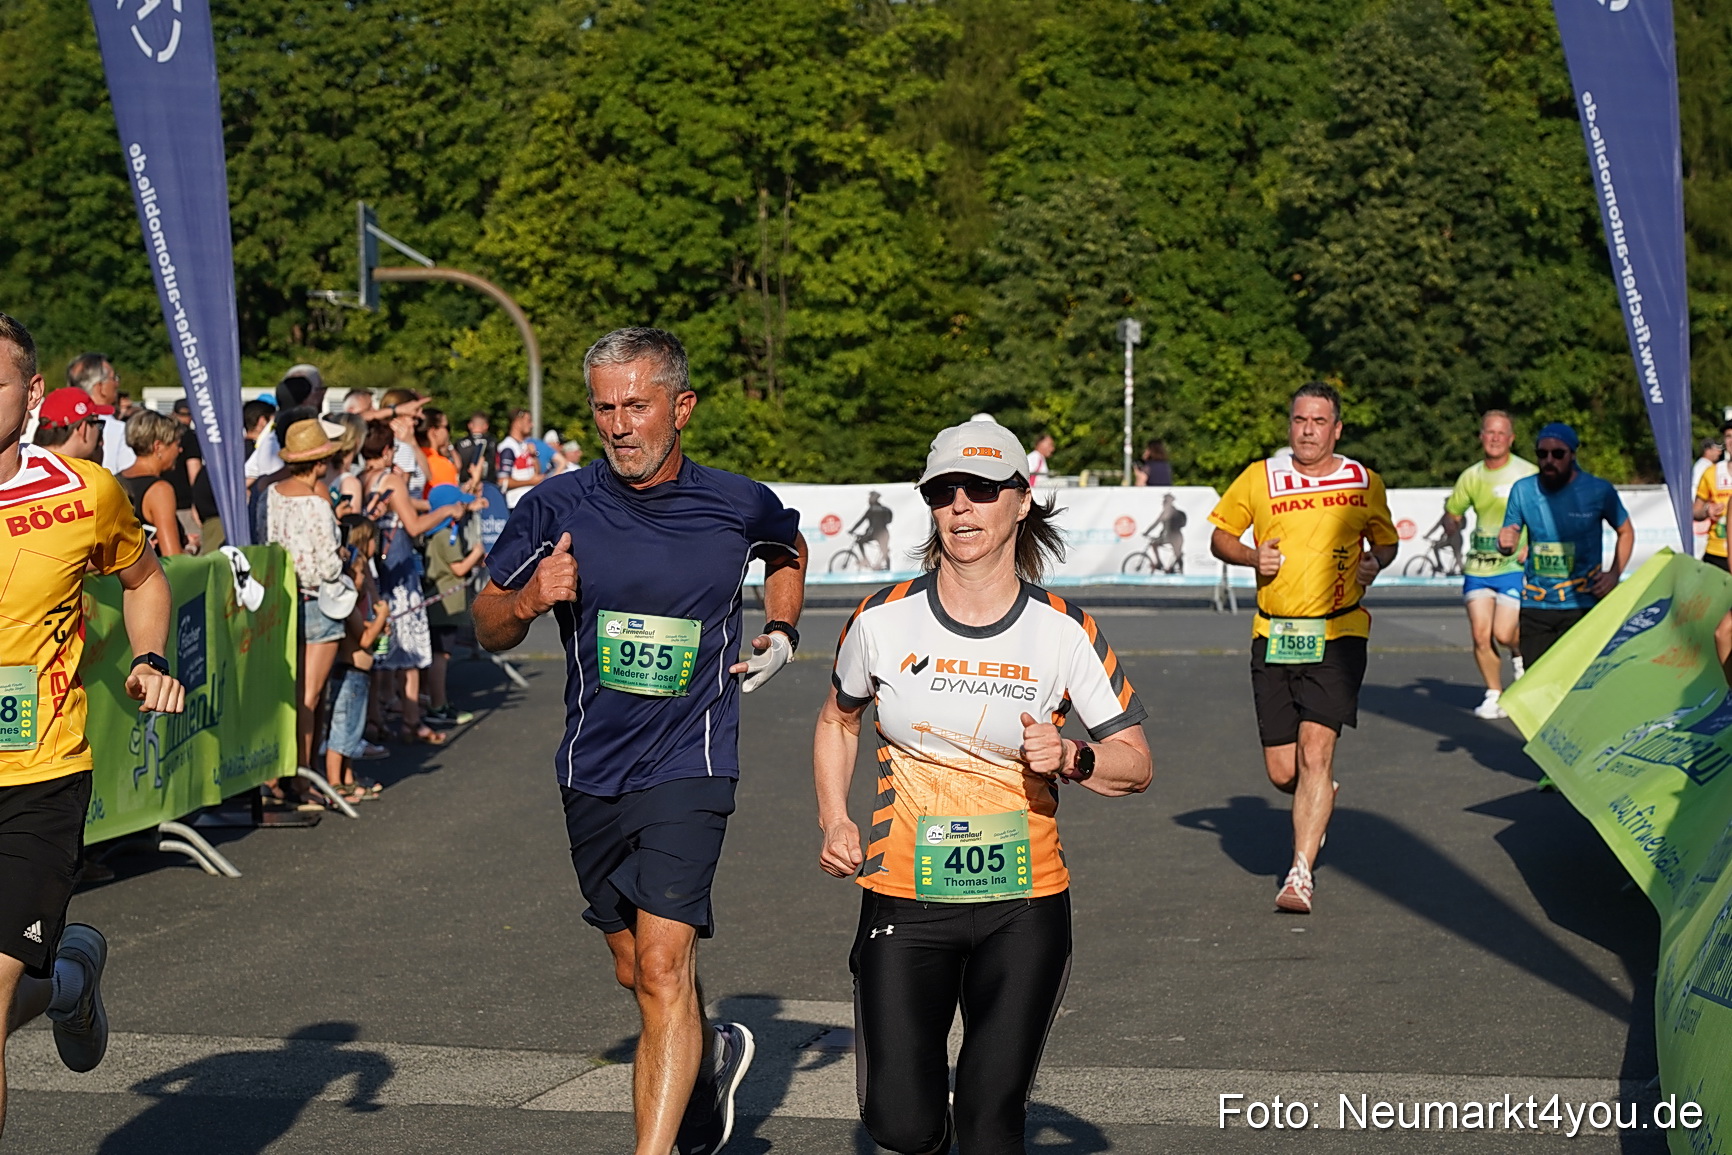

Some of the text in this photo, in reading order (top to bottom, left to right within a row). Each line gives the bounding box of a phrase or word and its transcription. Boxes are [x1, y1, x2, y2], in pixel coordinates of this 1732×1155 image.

[962, 446, 1003, 459] OBI
[1271, 493, 1368, 516] MAX BÖGL
[5, 499, 94, 537] BÖGL
[622, 628, 656, 636] Firmenlauf
[1279, 635, 1316, 650] 1588
[602, 646, 611, 673] RUN
[619, 640, 674, 671] 955
[613, 667, 678, 683] Mederer Josef
[678, 651, 693, 686] 2022
[935, 658, 1039, 683] KLEBL
[930, 677, 1038, 701] DYNAMICS
[21, 700, 31, 738] 2022
[945, 830, 983, 840] Firmenlauf
[922, 856, 932, 885] RUN
[944, 844, 1005, 874] 405
[1016, 845, 1027, 886] 2022
[944, 876, 1007, 887] Thomas Ina
